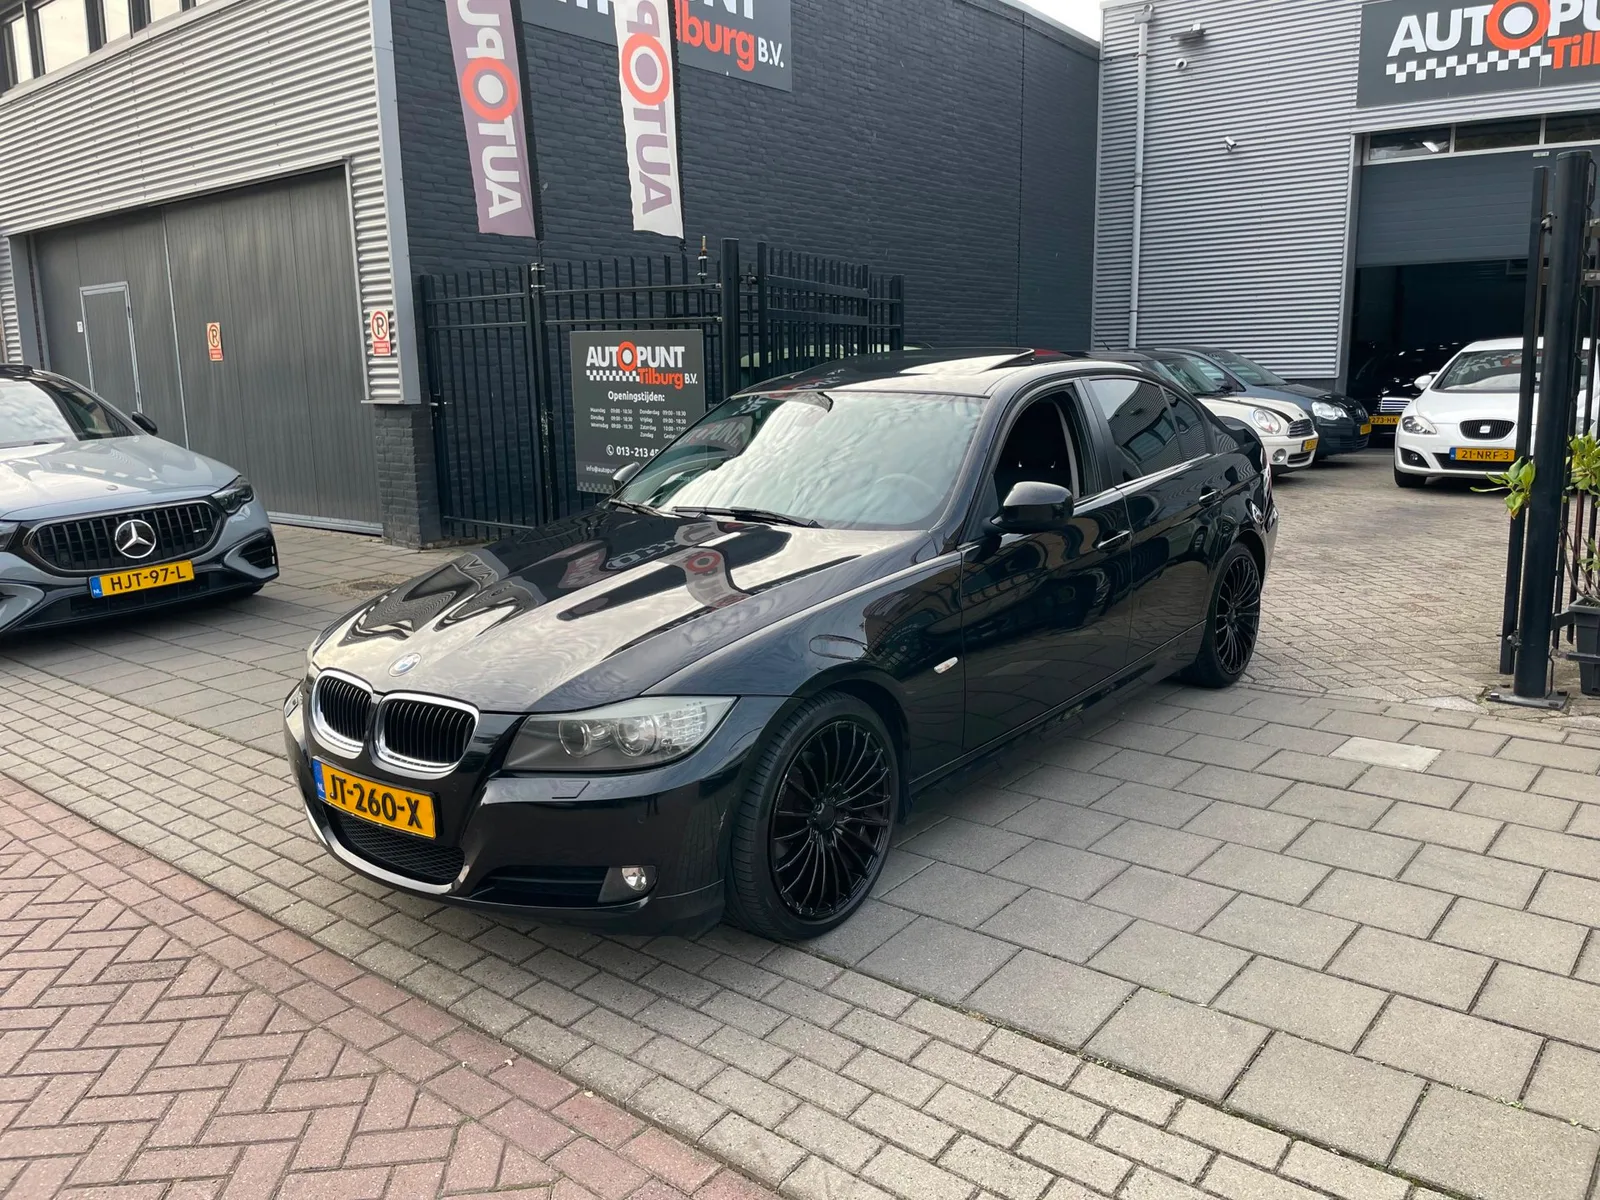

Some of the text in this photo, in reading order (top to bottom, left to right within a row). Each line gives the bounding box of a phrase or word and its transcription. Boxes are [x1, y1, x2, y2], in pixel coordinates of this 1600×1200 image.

[757, 36, 785, 69] B.V.
[1547, 31, 1600, 70] Til
[585, 341, 686, 372] AUTOPUNT
[637, 367, 698, 391] Tilburg B.V.
[607, 390, 666, 403] Openingstijden:
[1461, 450, 1509, 460] 21-NRF-3
[110, 565, 186, 591] HJT-97-L
[329, 774, 423, 829] JT-260-X
